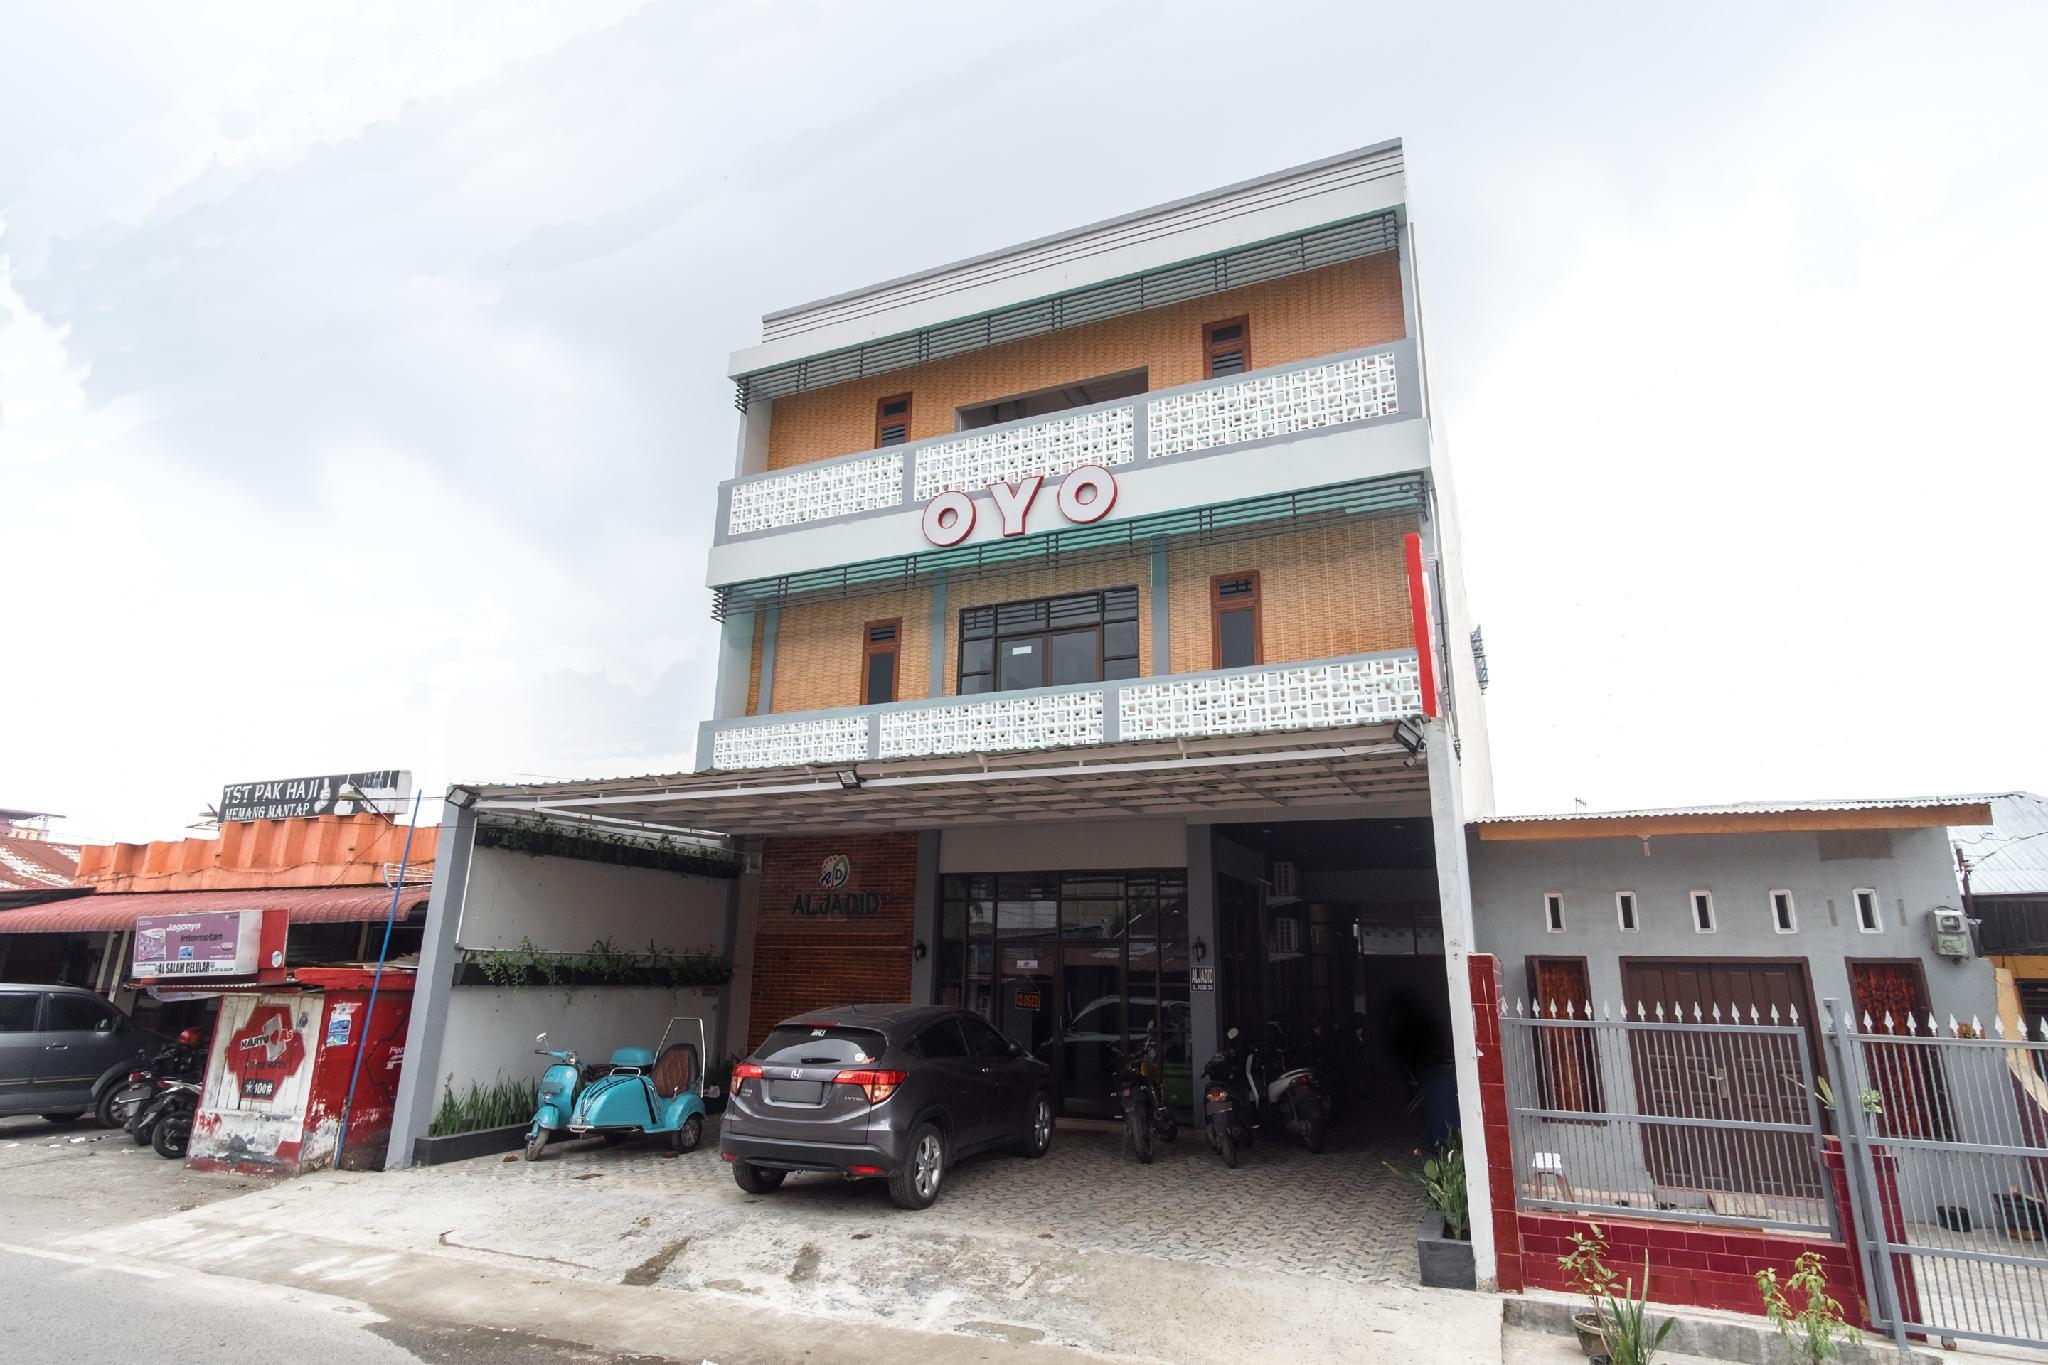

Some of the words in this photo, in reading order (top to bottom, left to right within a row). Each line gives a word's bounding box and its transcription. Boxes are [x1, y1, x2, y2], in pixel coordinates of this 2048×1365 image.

[922, 465, 1118, 547] OYO
[224, 784, 253, 804] TST
[254, 782, 284, 802] PAK
[286, 779, 320, 802] HAJI
[224, 806, 266, 820] MEMANG
[267, 803, 310, 818] MANTAP
[165, 962, 185, 974] SALAM
[185, 961, 210, 973] CELULAR
[1016, 994, 1040, 1008] CLOSED
[241, 1035, 269, 1048] KARTU
